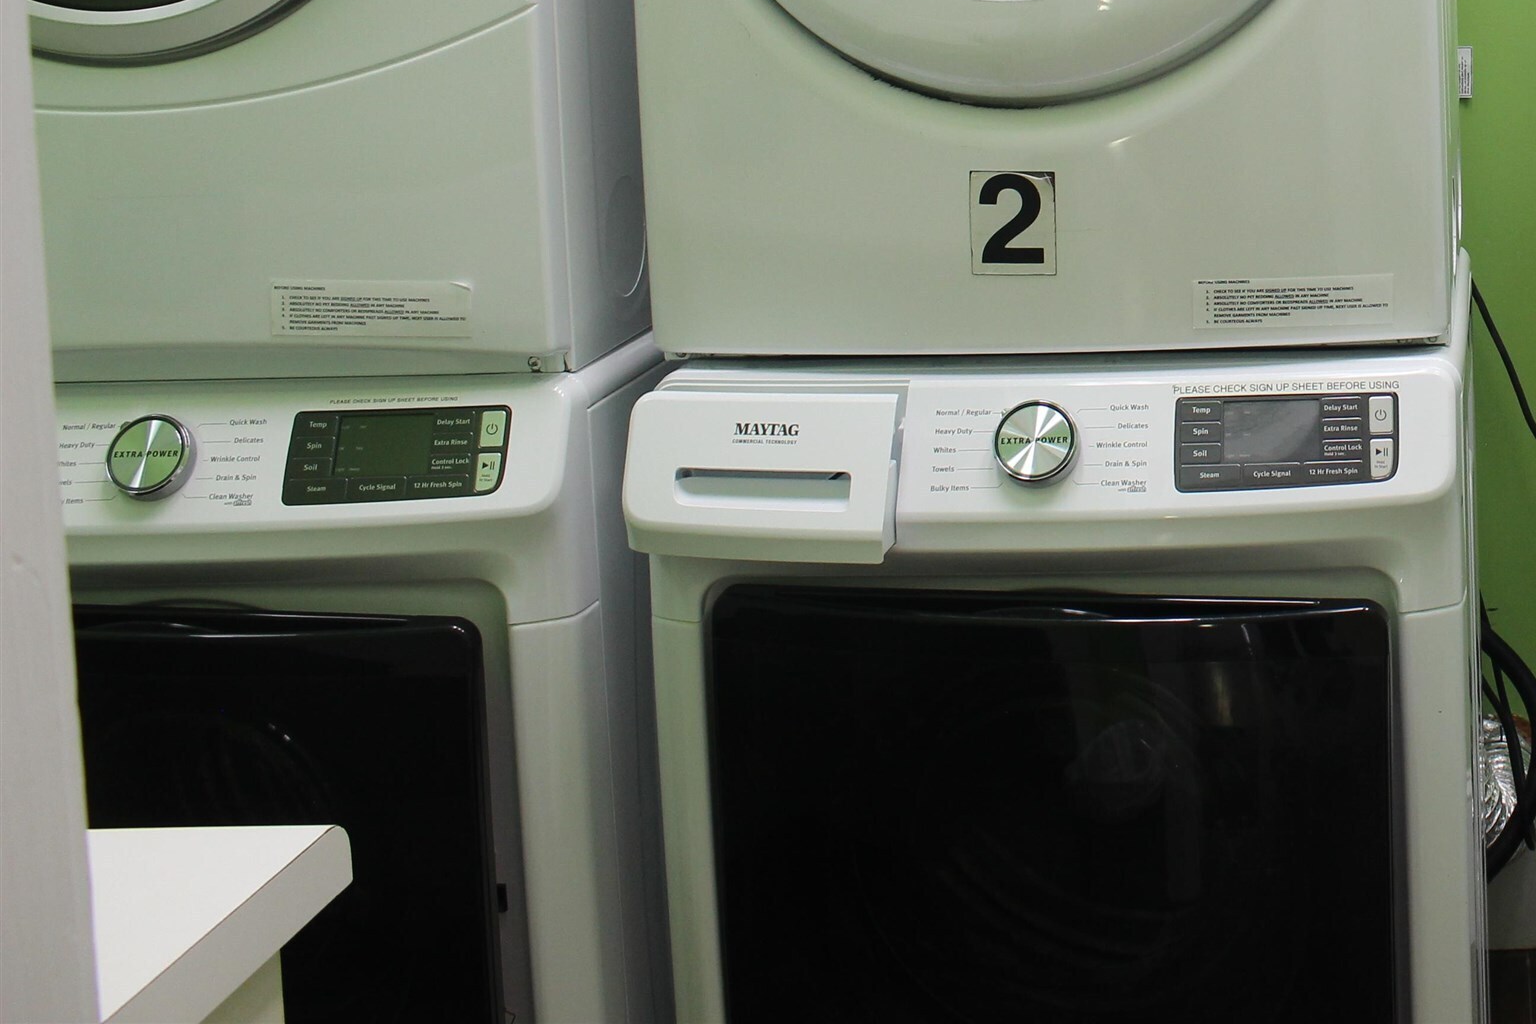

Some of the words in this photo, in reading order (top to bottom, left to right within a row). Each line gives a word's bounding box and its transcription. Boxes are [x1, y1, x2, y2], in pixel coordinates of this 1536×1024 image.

[979, 173, 1044, 263] 2
[1174, 386, 1210, 394] PLEASE
[1276, 383, 1289, 391] UP
[1327, 382, 1366, 390] BEFORE
[1369, 381, 1399, 389] USING
[733, 423, 799, 436] MAYTAG
[1001, 437, 1031, 445] EXTRA
